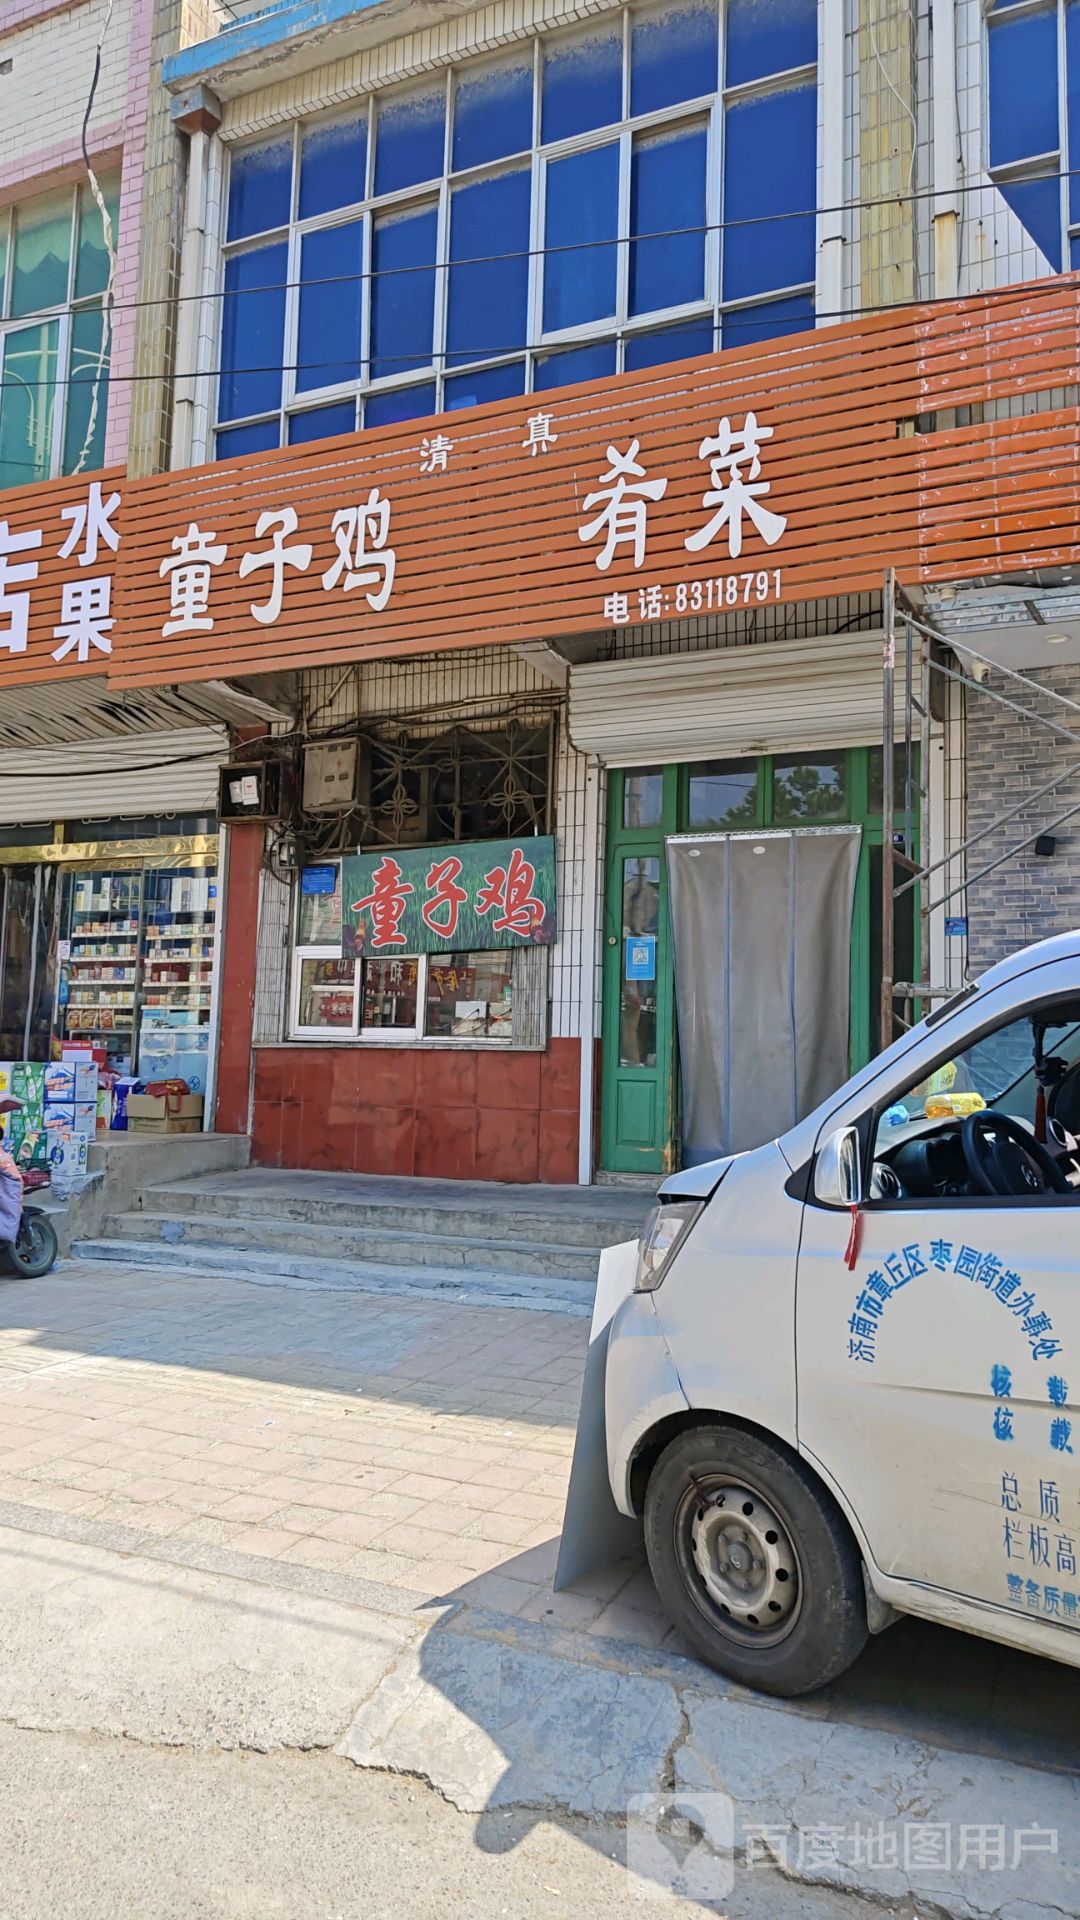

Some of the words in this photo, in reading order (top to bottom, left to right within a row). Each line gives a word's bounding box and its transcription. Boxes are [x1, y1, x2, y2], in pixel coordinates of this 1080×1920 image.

[419, 411, 558, 472] 清真
[159, 488, 397, 637] 童子鸡
[578, 411, 788, 571] 肴菜
[51, 481, 122, 662] 水果
[351, 848, 546, 948] 童子鸡
[1001, 1470, 1080, 1523] 总质
[1002, 1516, 1076, 1576] 栏板高
[1006, 1572, 1080, 1618] 整备质量
